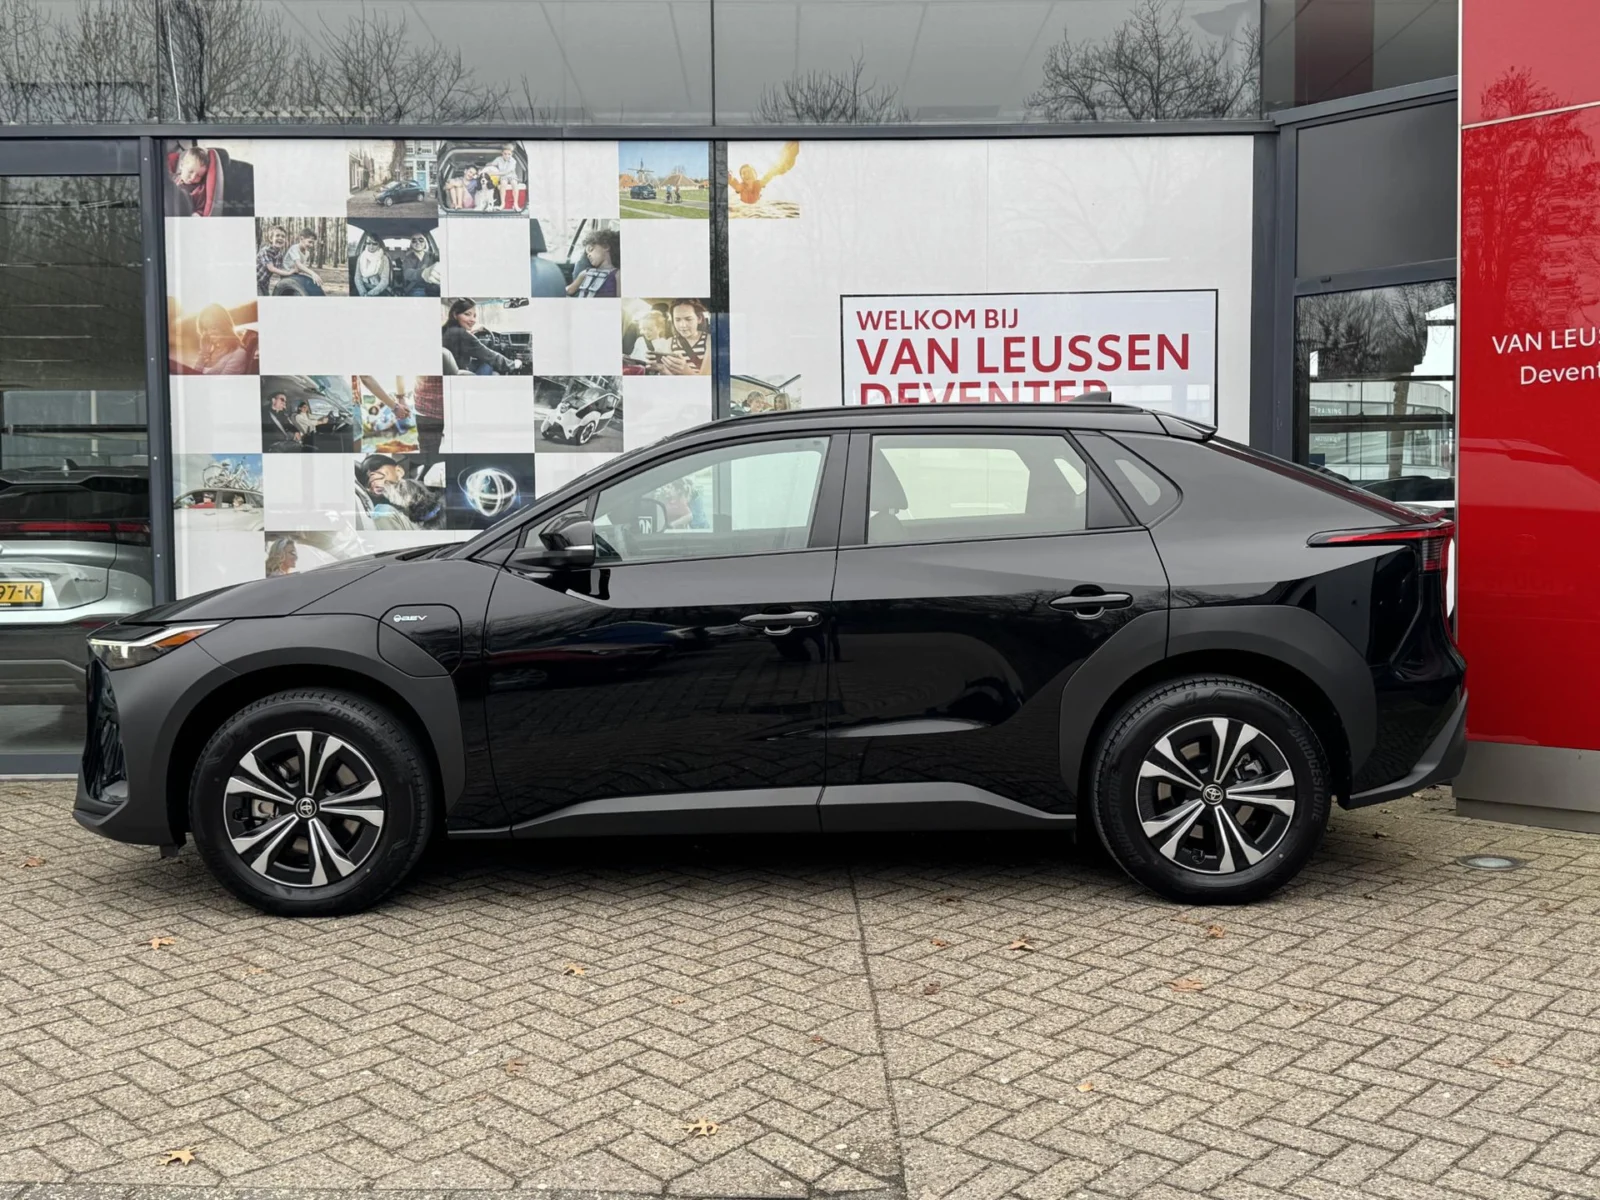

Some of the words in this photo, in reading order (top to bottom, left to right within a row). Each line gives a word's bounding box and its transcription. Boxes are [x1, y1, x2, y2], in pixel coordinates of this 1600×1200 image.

[856, 309, 976, 331] WELKOM
[984, 308, 1018, 329] BIJ
[856, 337, 959, 375] VAN
[977, 333, 1190, 374] LEUSSEN
[1491, 331, 1542, 355] VAN
[1550, 326, 1600, 350] LEU
